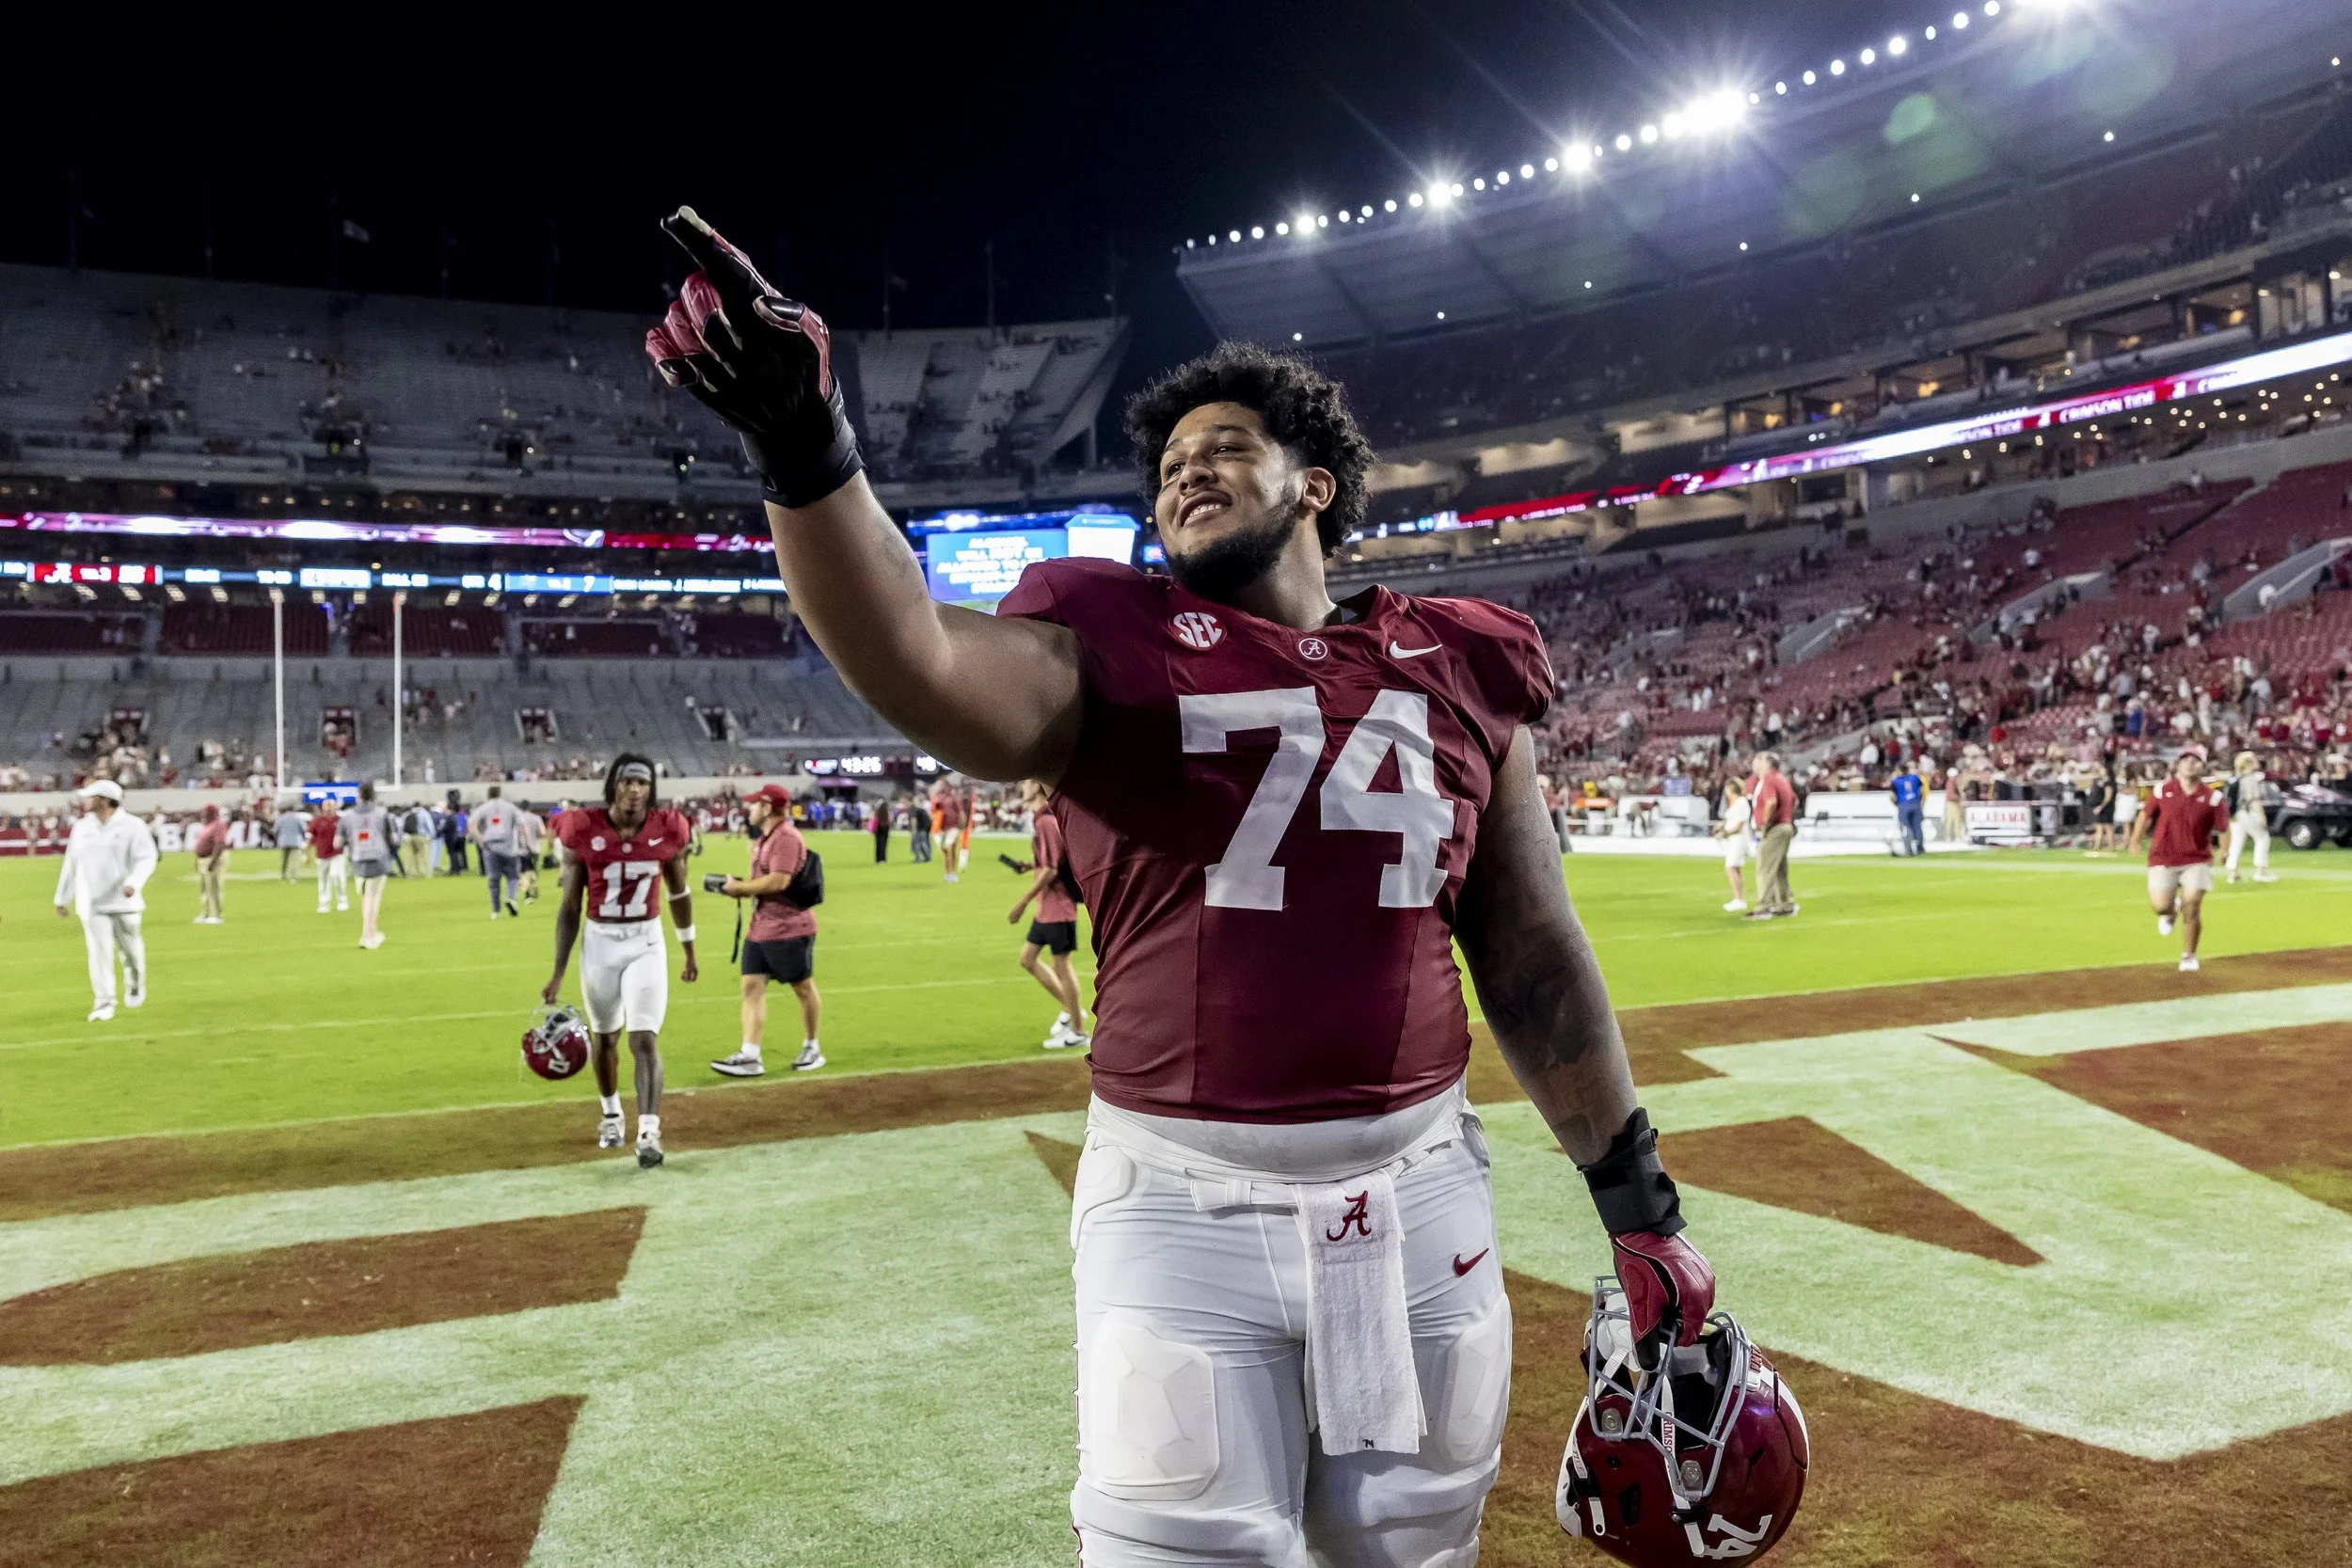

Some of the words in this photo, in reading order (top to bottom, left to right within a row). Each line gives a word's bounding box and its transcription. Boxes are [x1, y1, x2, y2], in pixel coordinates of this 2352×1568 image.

[1173, 611, 1222, 647] SEC
[1179, 686, 1454, 911] 74
[601, 861, 659, 917] 17
[1327, 1190, 1372, 1242] A
[1361, 1439, 1375, 1449] 74
[1693, 1513, 1772, 1560] 74
